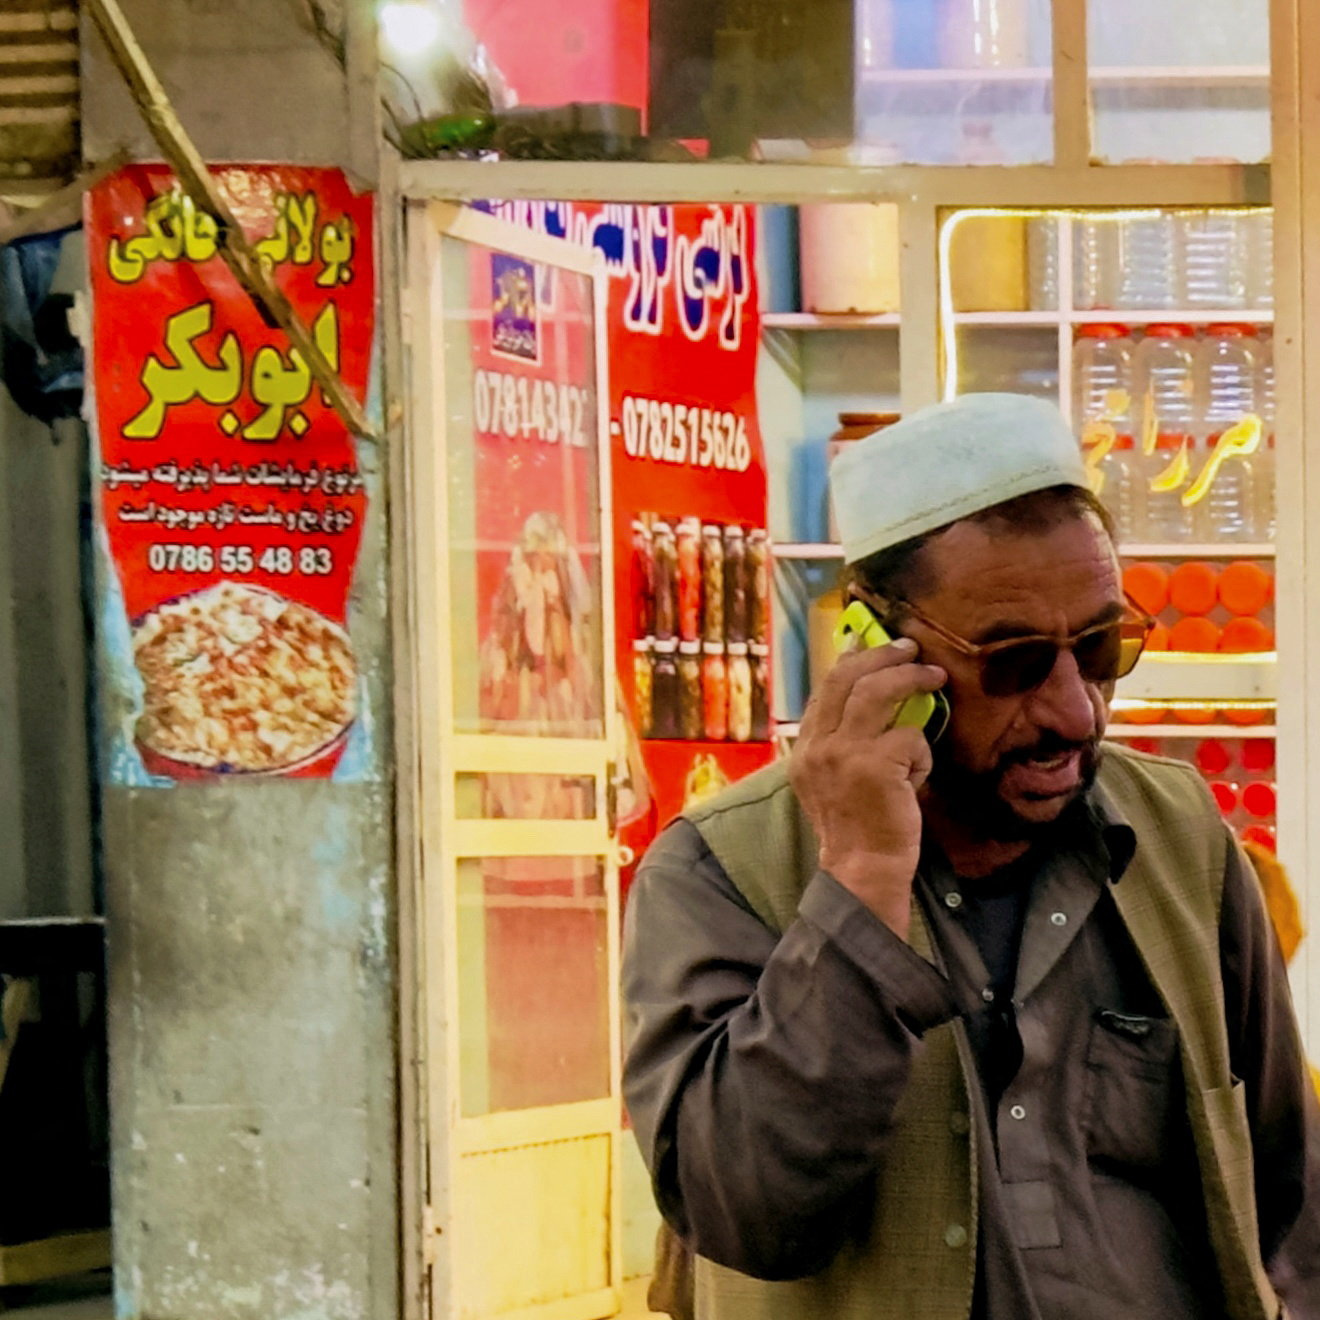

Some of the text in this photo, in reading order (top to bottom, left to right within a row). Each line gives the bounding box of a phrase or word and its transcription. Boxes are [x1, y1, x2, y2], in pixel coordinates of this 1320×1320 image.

[250, 190, 353, 287] بولان
[121, 300, 341, 441] ابوبکر
[474, 369, 750, 472] 07814342 0782515626
[149, 543, 333, 575] 0786 55 48 83
